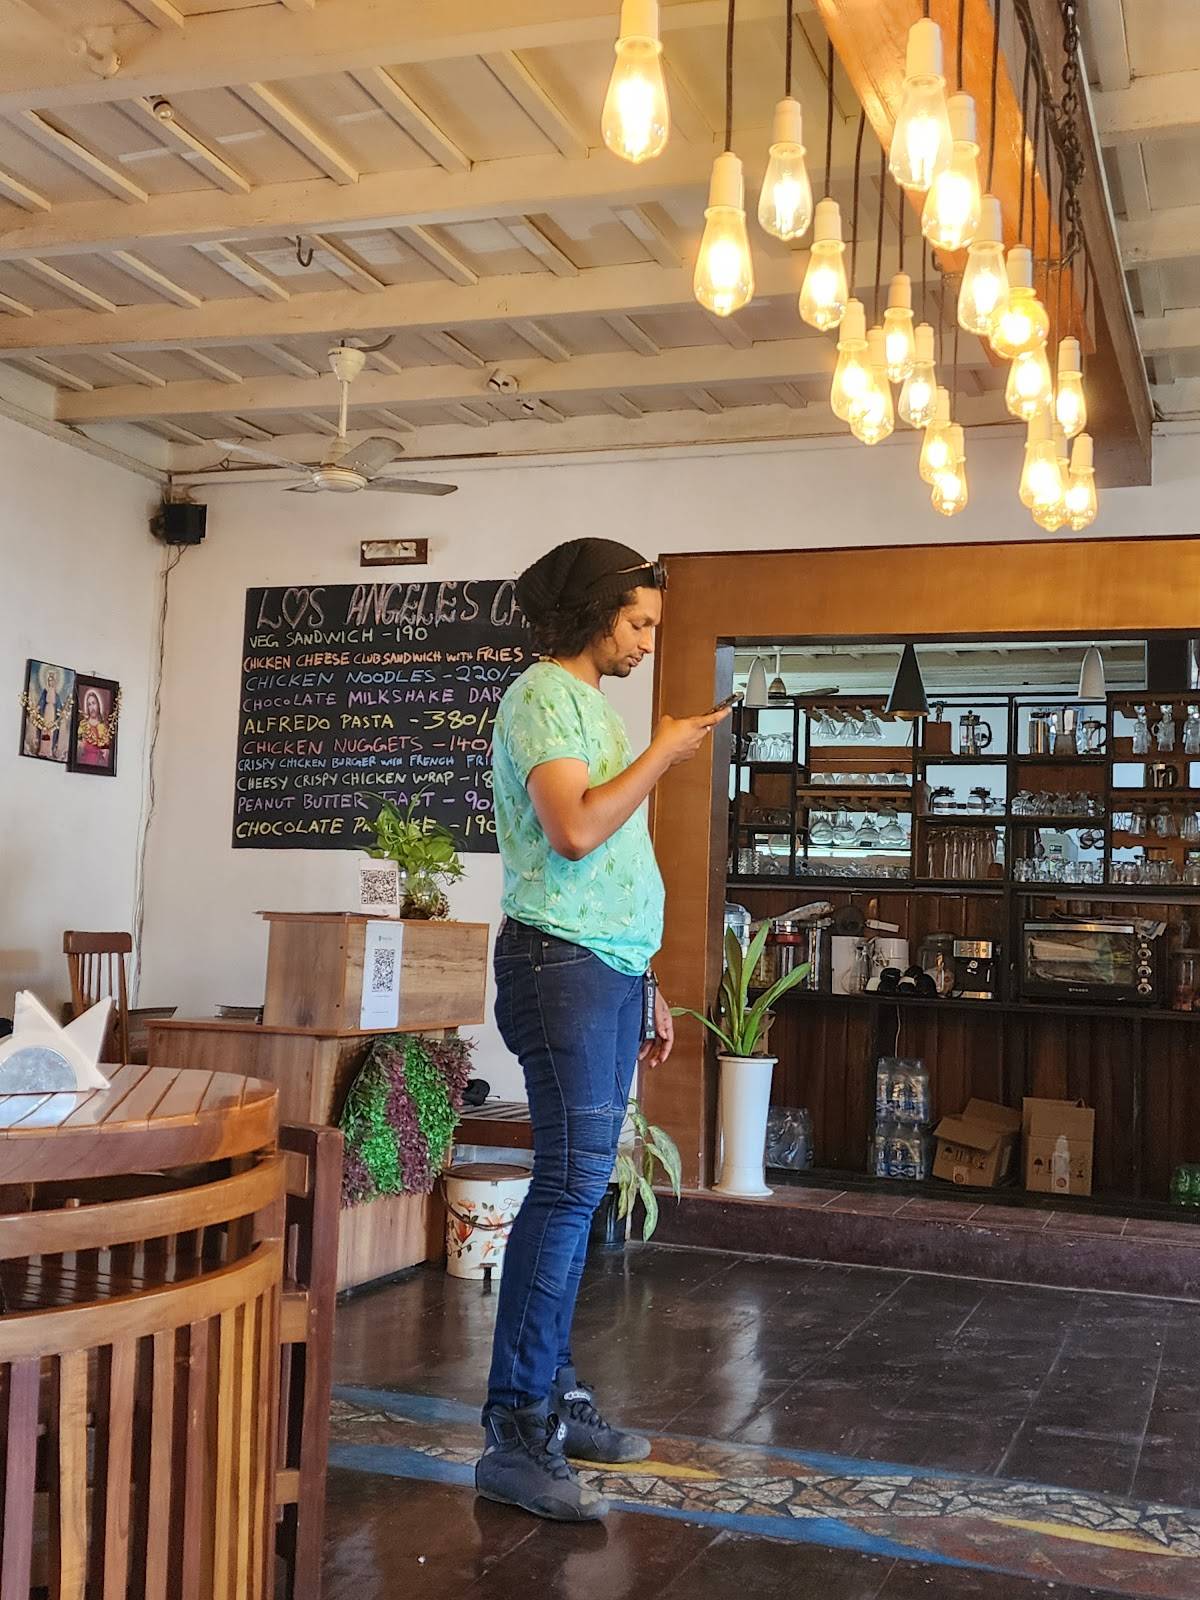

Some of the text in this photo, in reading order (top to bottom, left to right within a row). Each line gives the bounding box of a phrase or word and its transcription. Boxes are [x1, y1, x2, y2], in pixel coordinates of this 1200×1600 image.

[344, 580, 479, 629] ANGELES
[490, 580, 530, 629] CA
[286, 628, 373, 647] SANDWICH
[243, 655, 291, 673] CHICKEN
[296, 652, 350, 667] CHEESE
[476, 645, 523, 662] FRIES
[245, 672, 334, 691] CHICKEN
[345, 670, 436, 684] NOODLES
[347, 688, 454, 709] MILKSHAKE
[243, 714, 331, 735] ALFREDO
[340, 713, 394, 729] PASTA
[242, 739, 323, 755] CHICKEN
[333, 735, 423, 753] NUGGETS
[237, 758, 275, 771] CRISPY
[279, 757, 327, 769] CHICKEN
[331, 755, 377, 769] BURGER
[409, 754, 455, 767] FRENCH
[466, 754, 494, 769] FRI
[236, 775, 289, 792] CHEESY
[294, 772, 338, 788] CRISPY
[341, 771, 407, 786] CHICKEN
[412, 771, 454, 786] WRAP
[237, 797, 296, 815] PEANUT
[303, 792, 369, 810] BUTTER
[235, 818, 345, 839] CHOCOLATE
